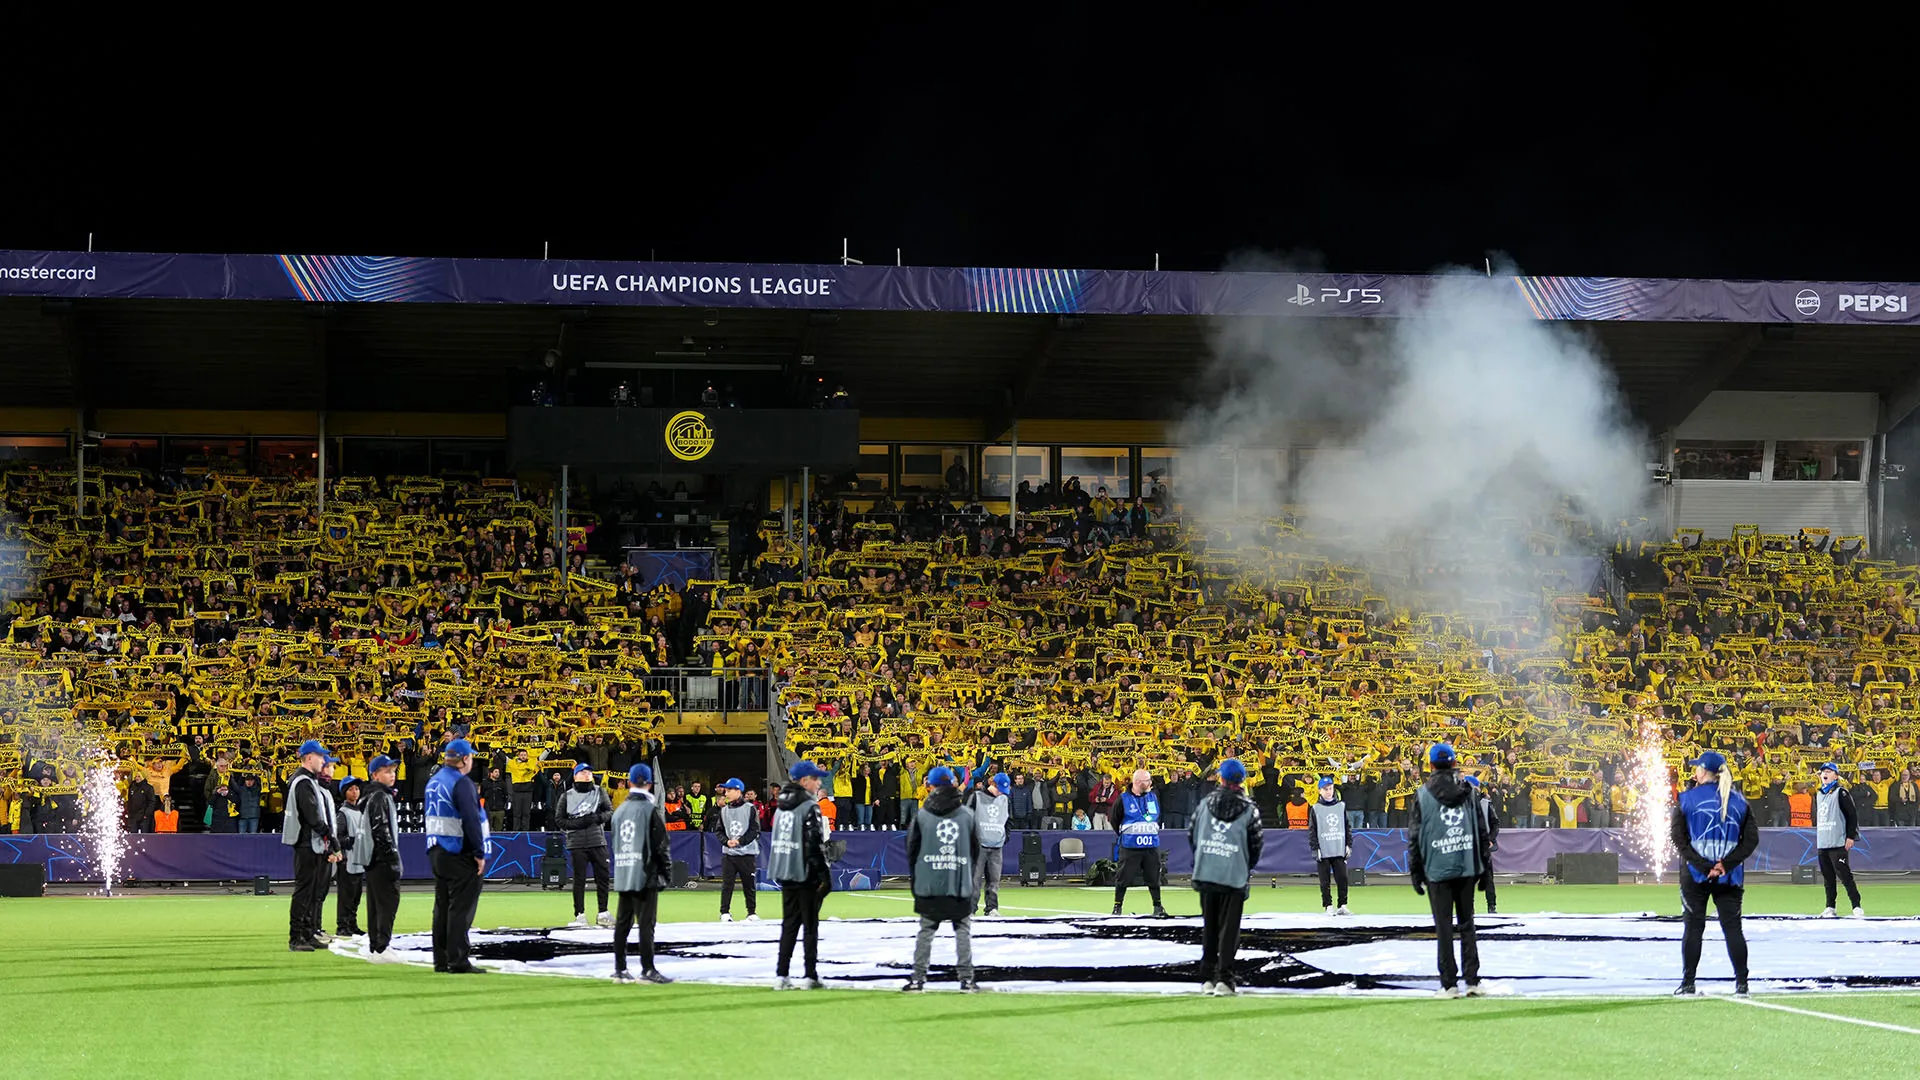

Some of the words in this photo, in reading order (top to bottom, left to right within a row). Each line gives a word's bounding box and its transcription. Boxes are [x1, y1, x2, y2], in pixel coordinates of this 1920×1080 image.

[552, 274, 609, 291] UEFA
[615, 275, 742, 294] CHAMPIONS
[750, 277, 831, 295] LEAGUE
[1320, 287, 1382, 303] PS5
[1796, 298, 1819, 306] PEPSI
[1838, 294, 1908, 313] PEPSI
[1136, 836, 1153, 846] 001
